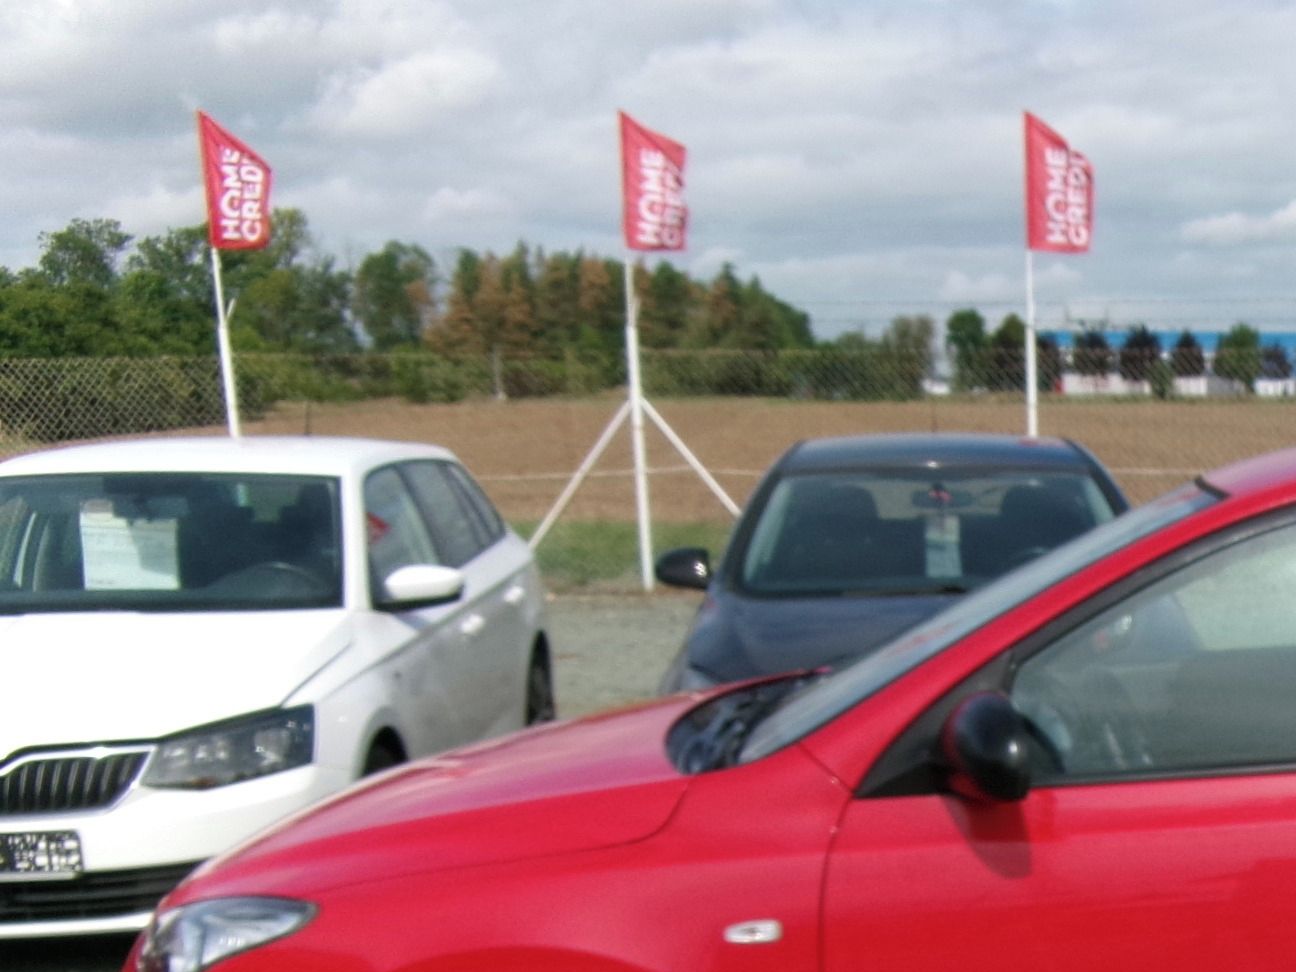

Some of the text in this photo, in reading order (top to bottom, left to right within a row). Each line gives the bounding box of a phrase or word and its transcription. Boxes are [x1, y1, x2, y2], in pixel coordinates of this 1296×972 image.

[220, 147, 241, 239] HOME
[636, 148, 664, 244] HOME
[1045, 148, 1067, 244] HOME
